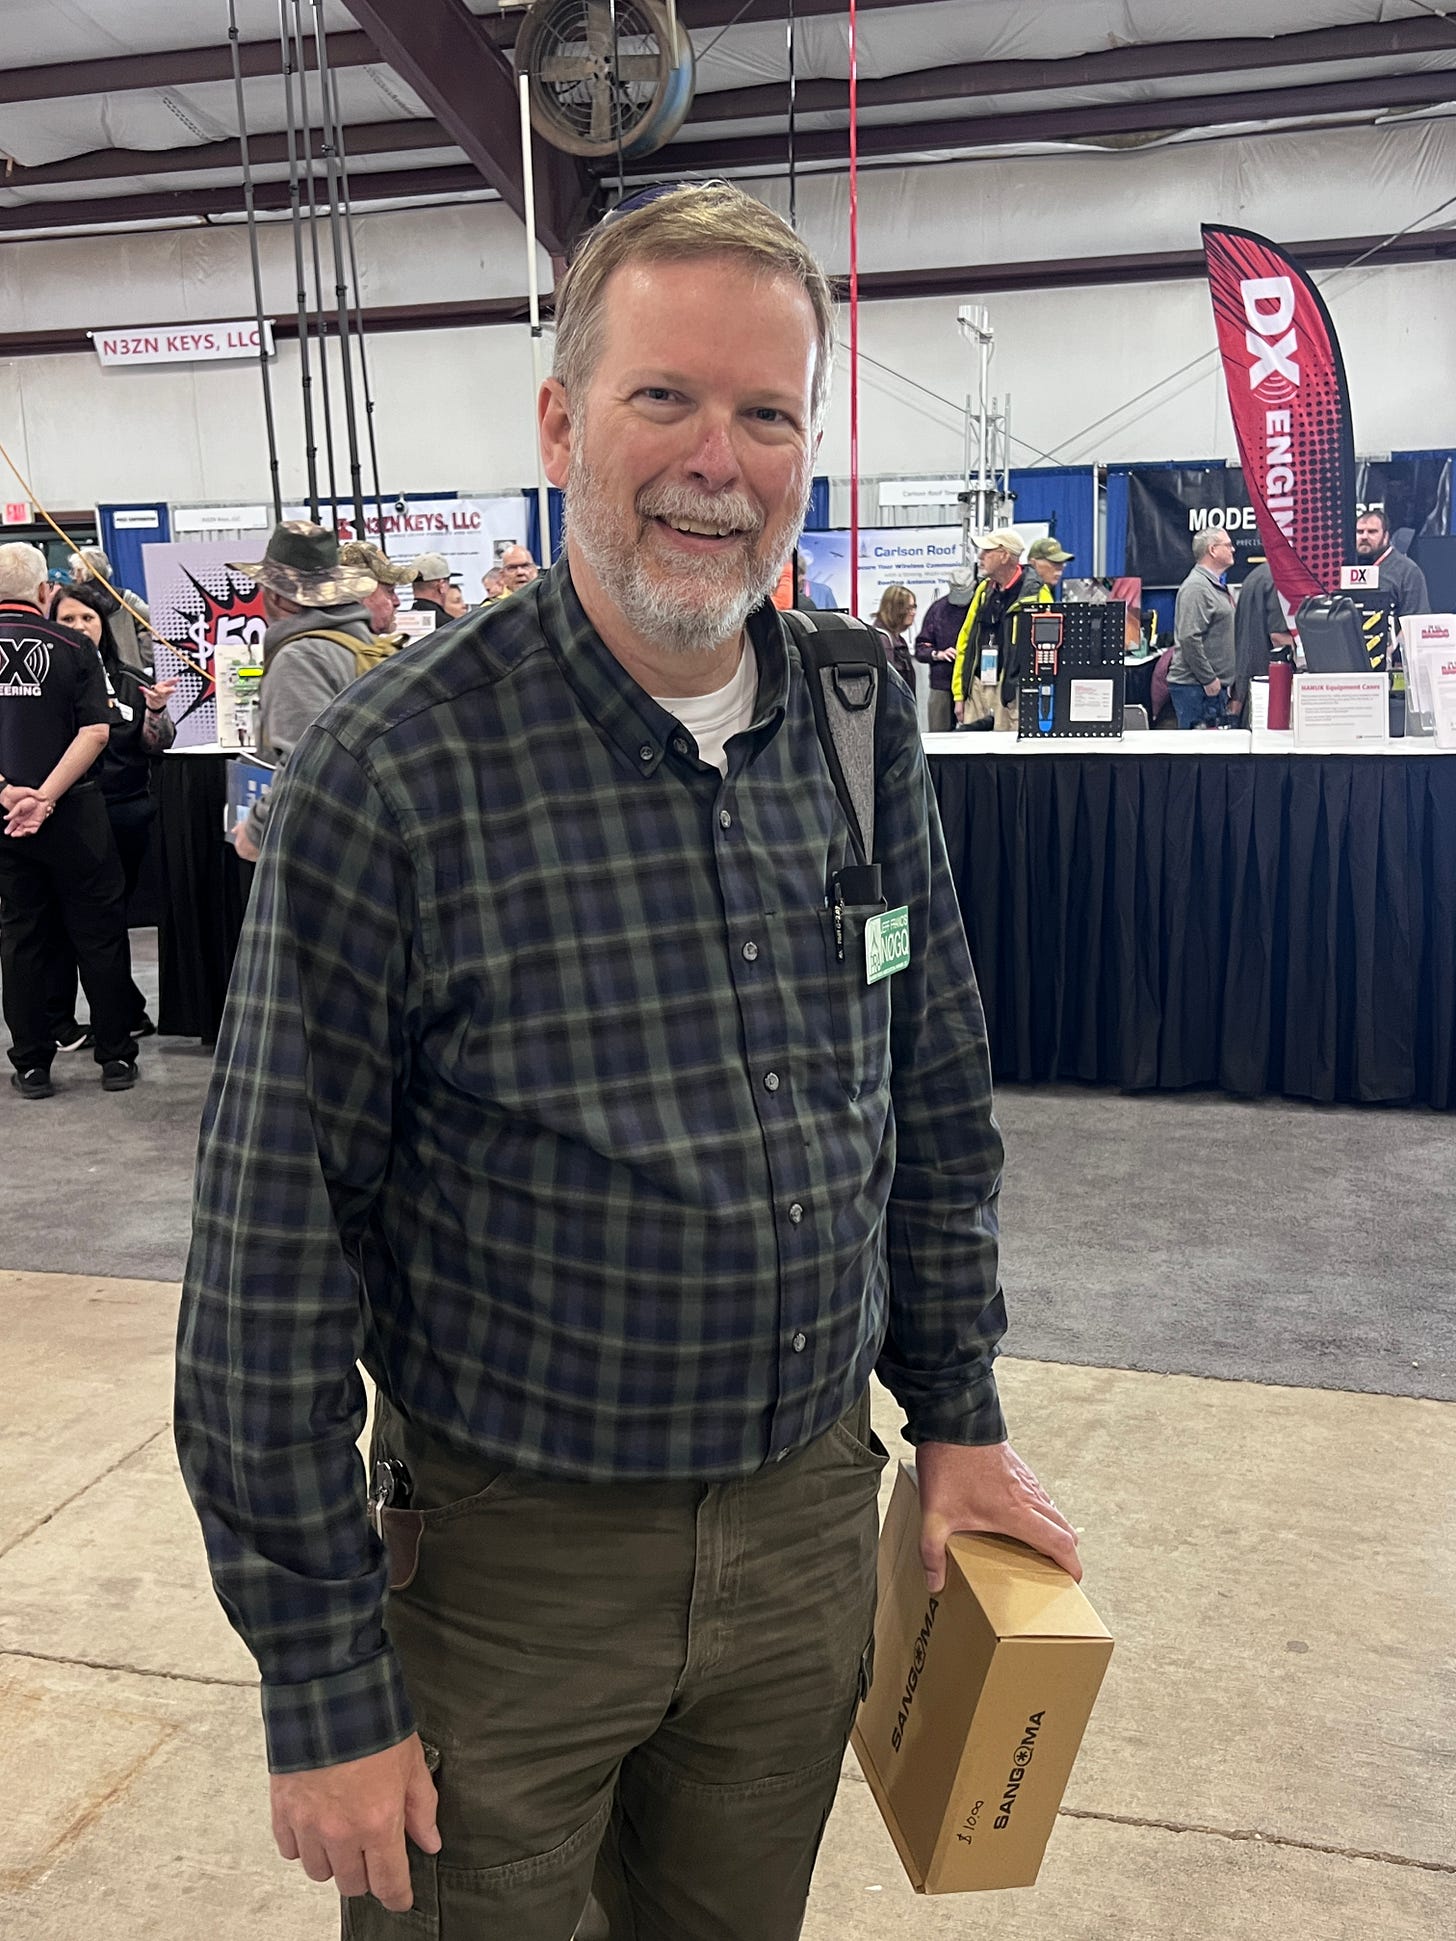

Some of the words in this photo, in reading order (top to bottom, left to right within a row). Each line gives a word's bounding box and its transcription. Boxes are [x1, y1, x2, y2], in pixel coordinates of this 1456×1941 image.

[103, 337, 159, 356] N3ZN
[166, 334, 220, 352] KEYS,
[227, 330, 261, 348] LLC
[1240, 276, 1300, 390] DX
[1265, 409, 1296, 547] ENGIN
[364, 514, 401, 535] N3ZN
[403, 513, 449, 533] KEYS,
[452, 512, 482, 530] LLC
[1189, 506, 1257, 532] MODE
[874, 546, 923, 558] Carlson
[927, 544, 956, 556] Roof
[1349, 569, 1367, 582] DX
[0, 638, 43, 687] X
[992, 1710, 1046, 1830] SANGOMA
